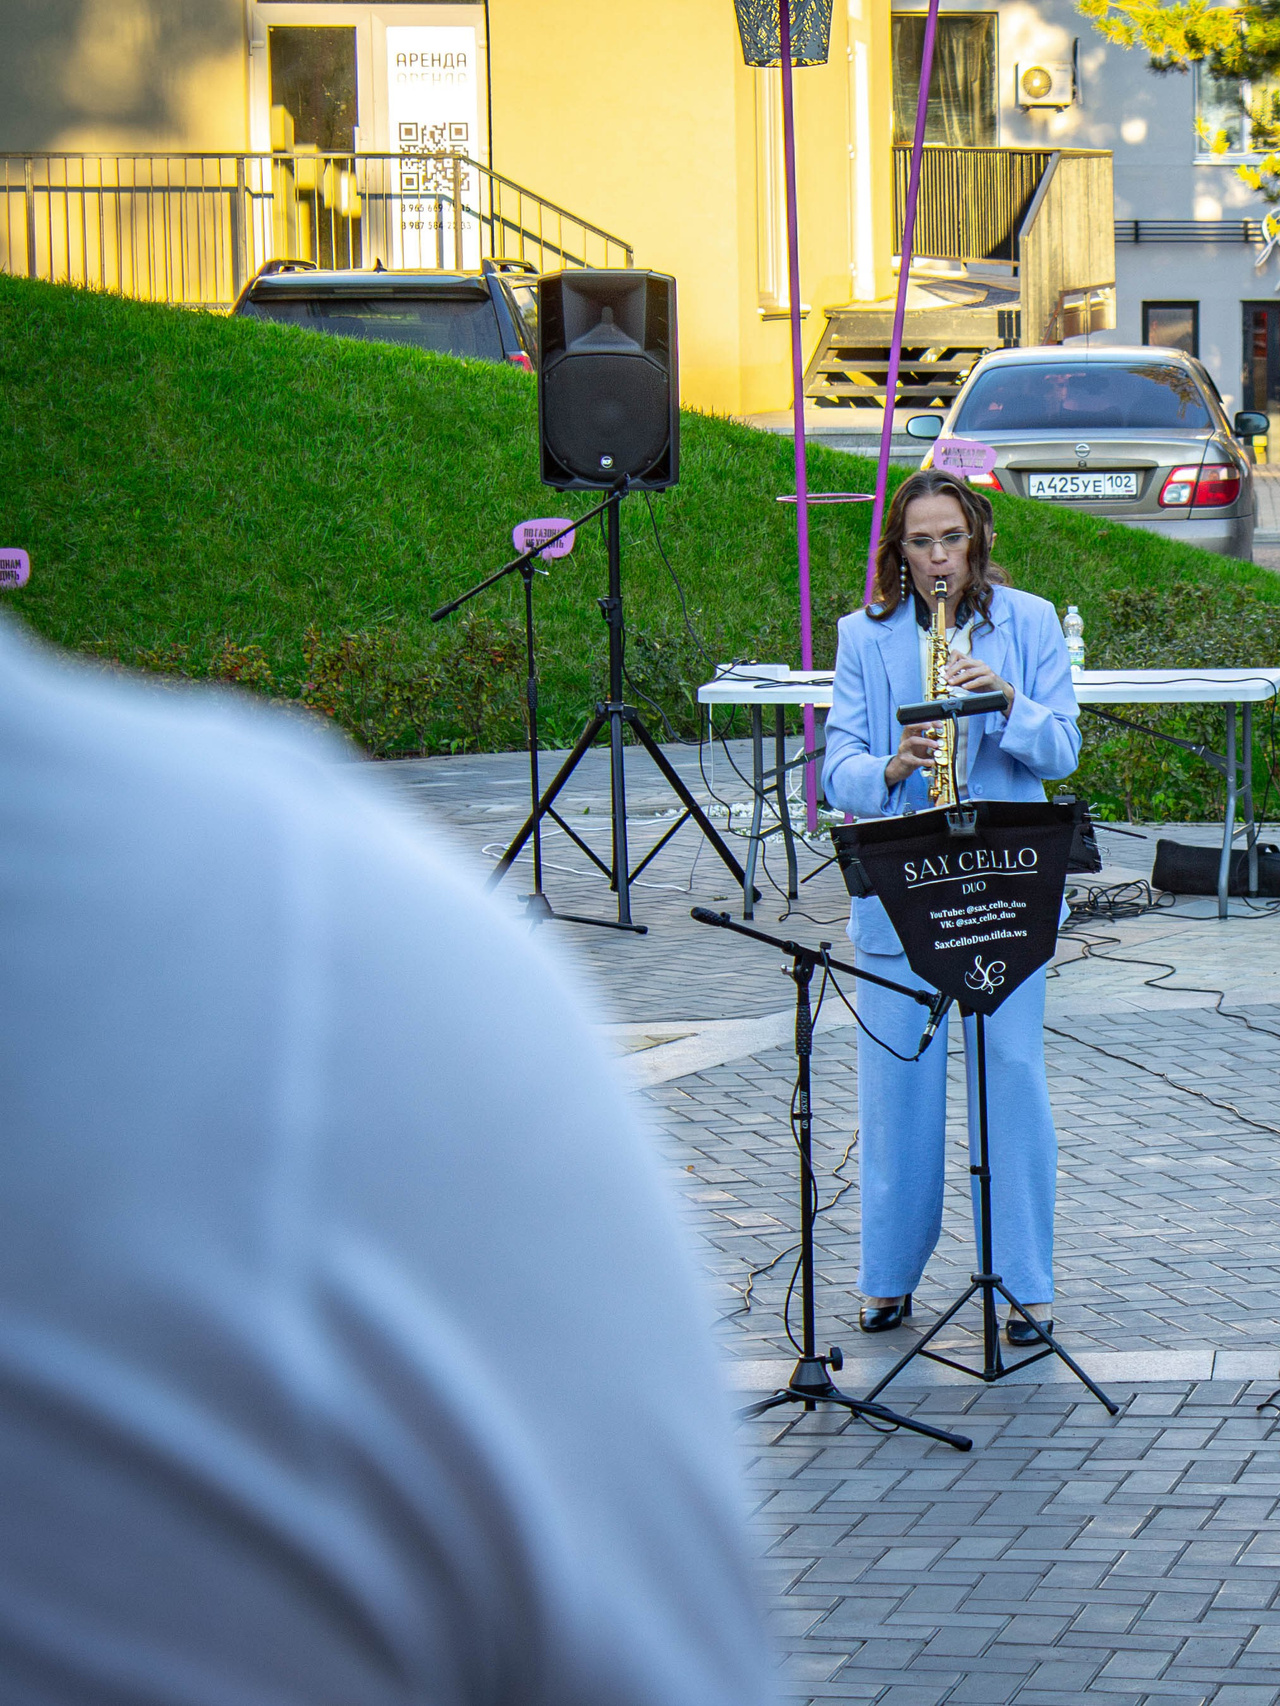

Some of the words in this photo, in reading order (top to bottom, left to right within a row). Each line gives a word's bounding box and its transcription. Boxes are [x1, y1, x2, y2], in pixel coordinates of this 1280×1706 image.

[396, 53, 467, 69] АРЕНДА
[409, 221, 425, 230] 987
[1106, 475, 1132, 489] 102
[523, 528, 534, 538] ПО
[0, 559, 21, 570] ОНАМ
[904, 854, 950, 882] SAX
[958, 847, 1038, 872] CELLO
[961, 880, 987, 895] DUO
[929, 907, 966, 919] YouTube:
[966, 900, 1027, 915] @sax_cello_duo
[940, 919, 955, 929] VK:
[955, 911, 1016, 928] @sax_cello_duo
[934, 929, 1028, 950] SaxCelloDuo.tilda.ws
